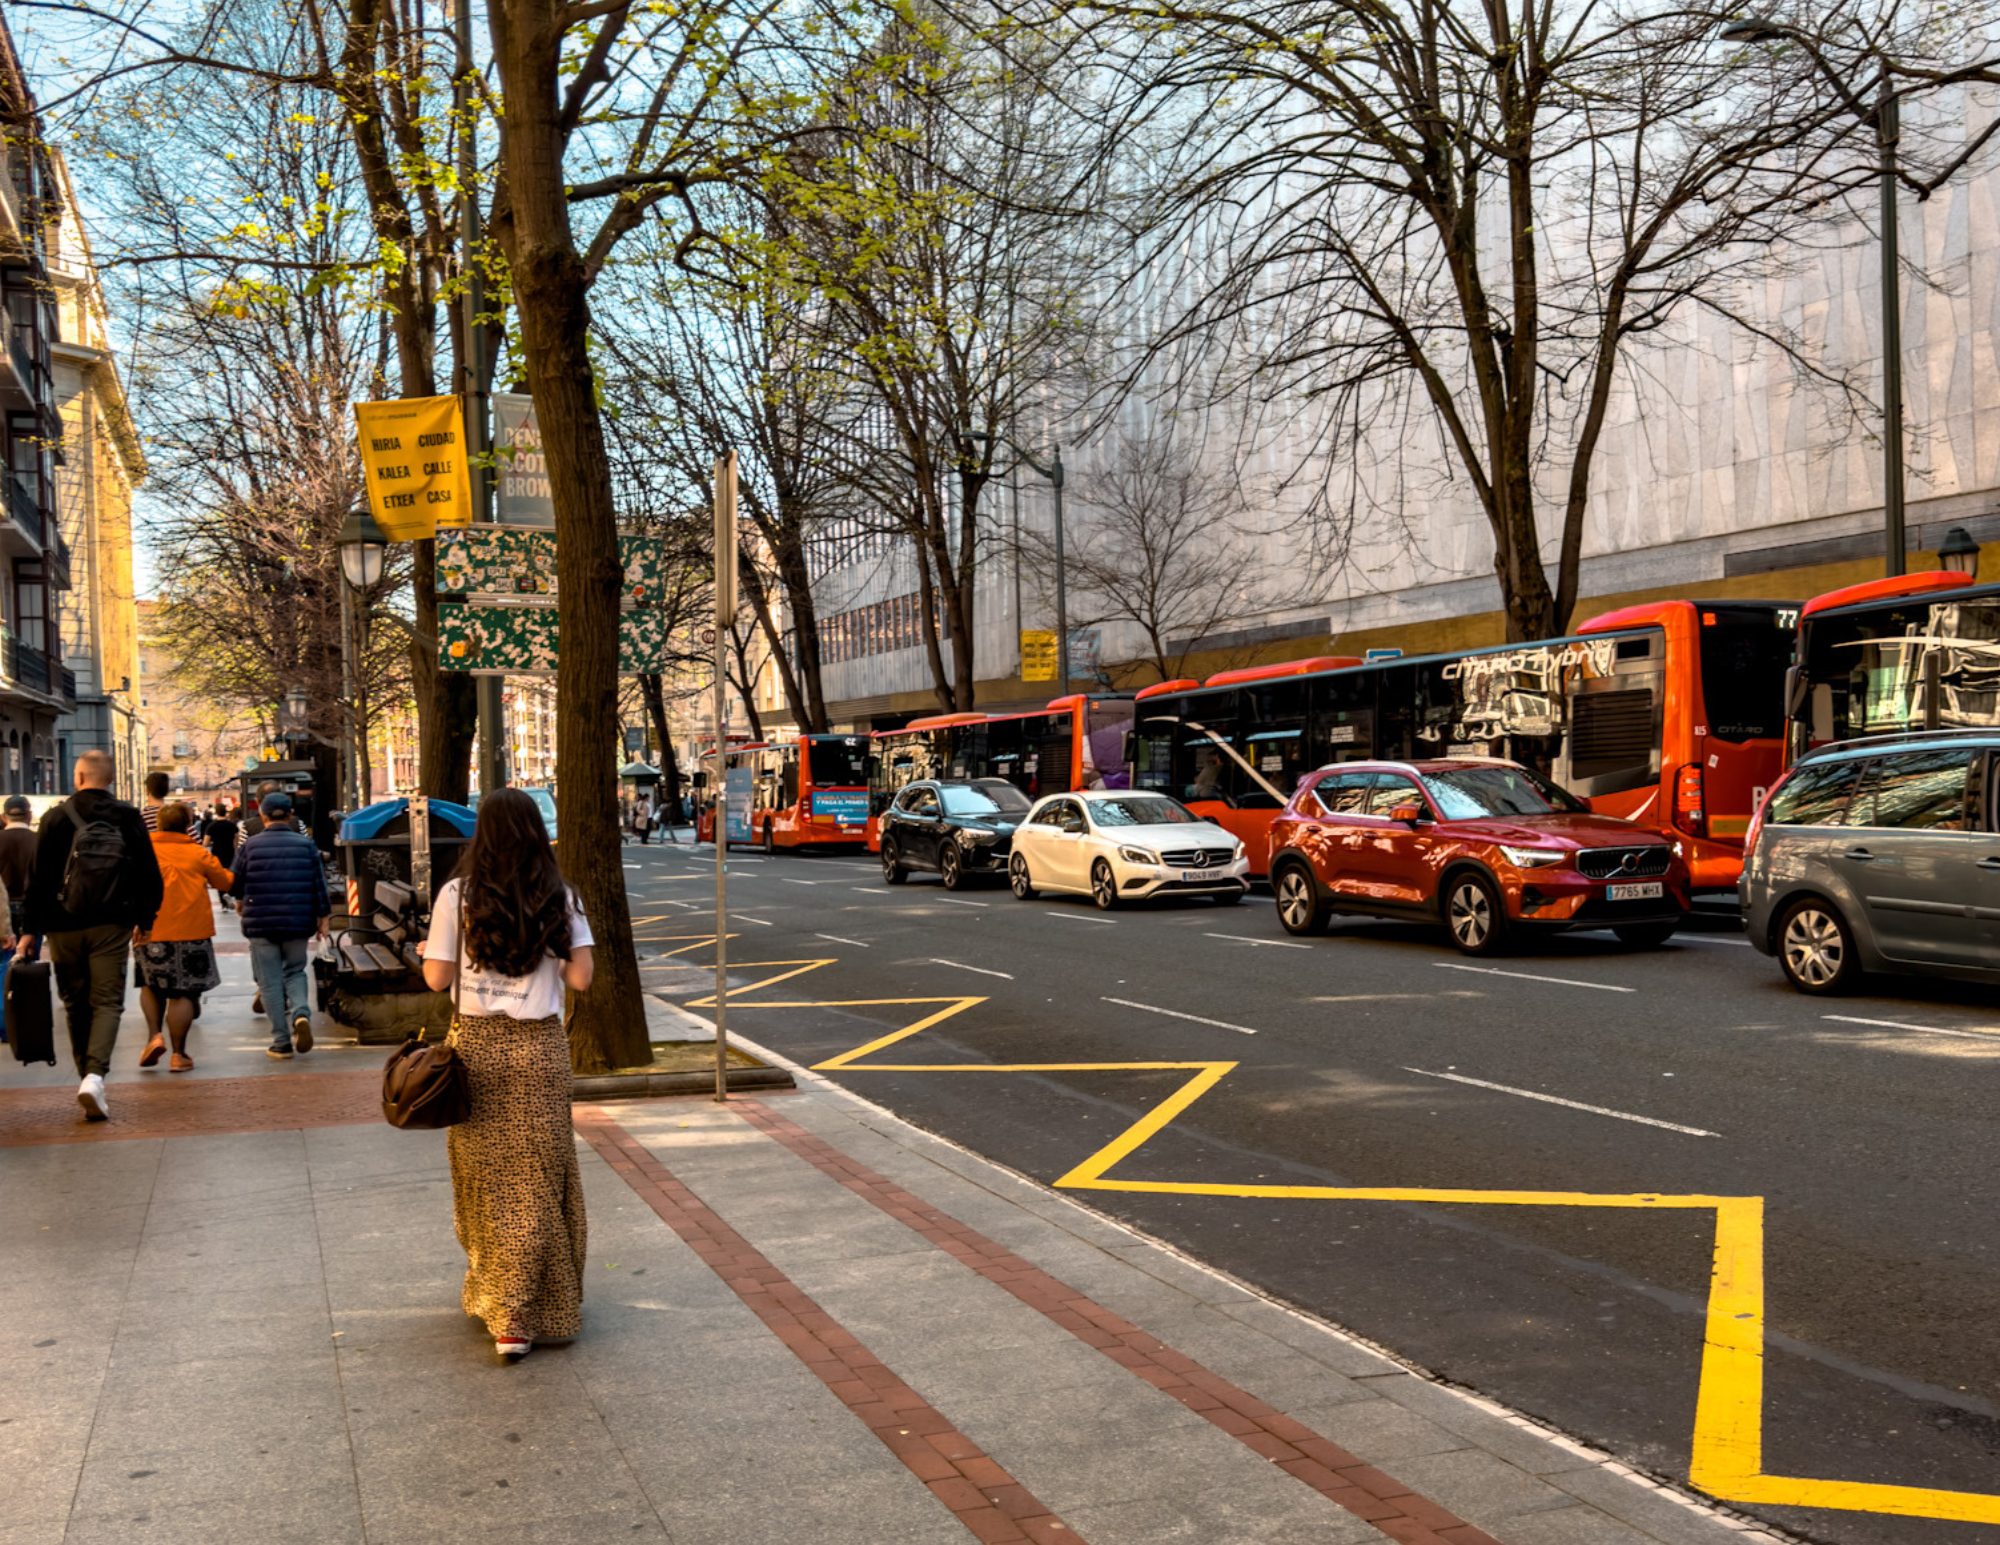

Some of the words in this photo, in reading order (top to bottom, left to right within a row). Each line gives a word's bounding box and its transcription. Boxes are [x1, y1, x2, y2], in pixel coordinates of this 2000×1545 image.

[372, 437, 401, 451] HIRIA
[418, 432, 455, 447] CIUDAD
[377, 465, 411, 480] KALEA
[423, 461, 452, 476] CALLE
[383, 493, 415, 509] ETXEA
[427, 490, 451, 504] CASA
[1777, 610, 1798, 628] 77
[1441, 654, 1526, 680] CITARO
[1718, 725, 1763, 734] CITARO
[1614, 886, 1640, 899] 7765
[1642, 884, 1661, 896] MHX
[492, 987, 528, 1000] iconique
